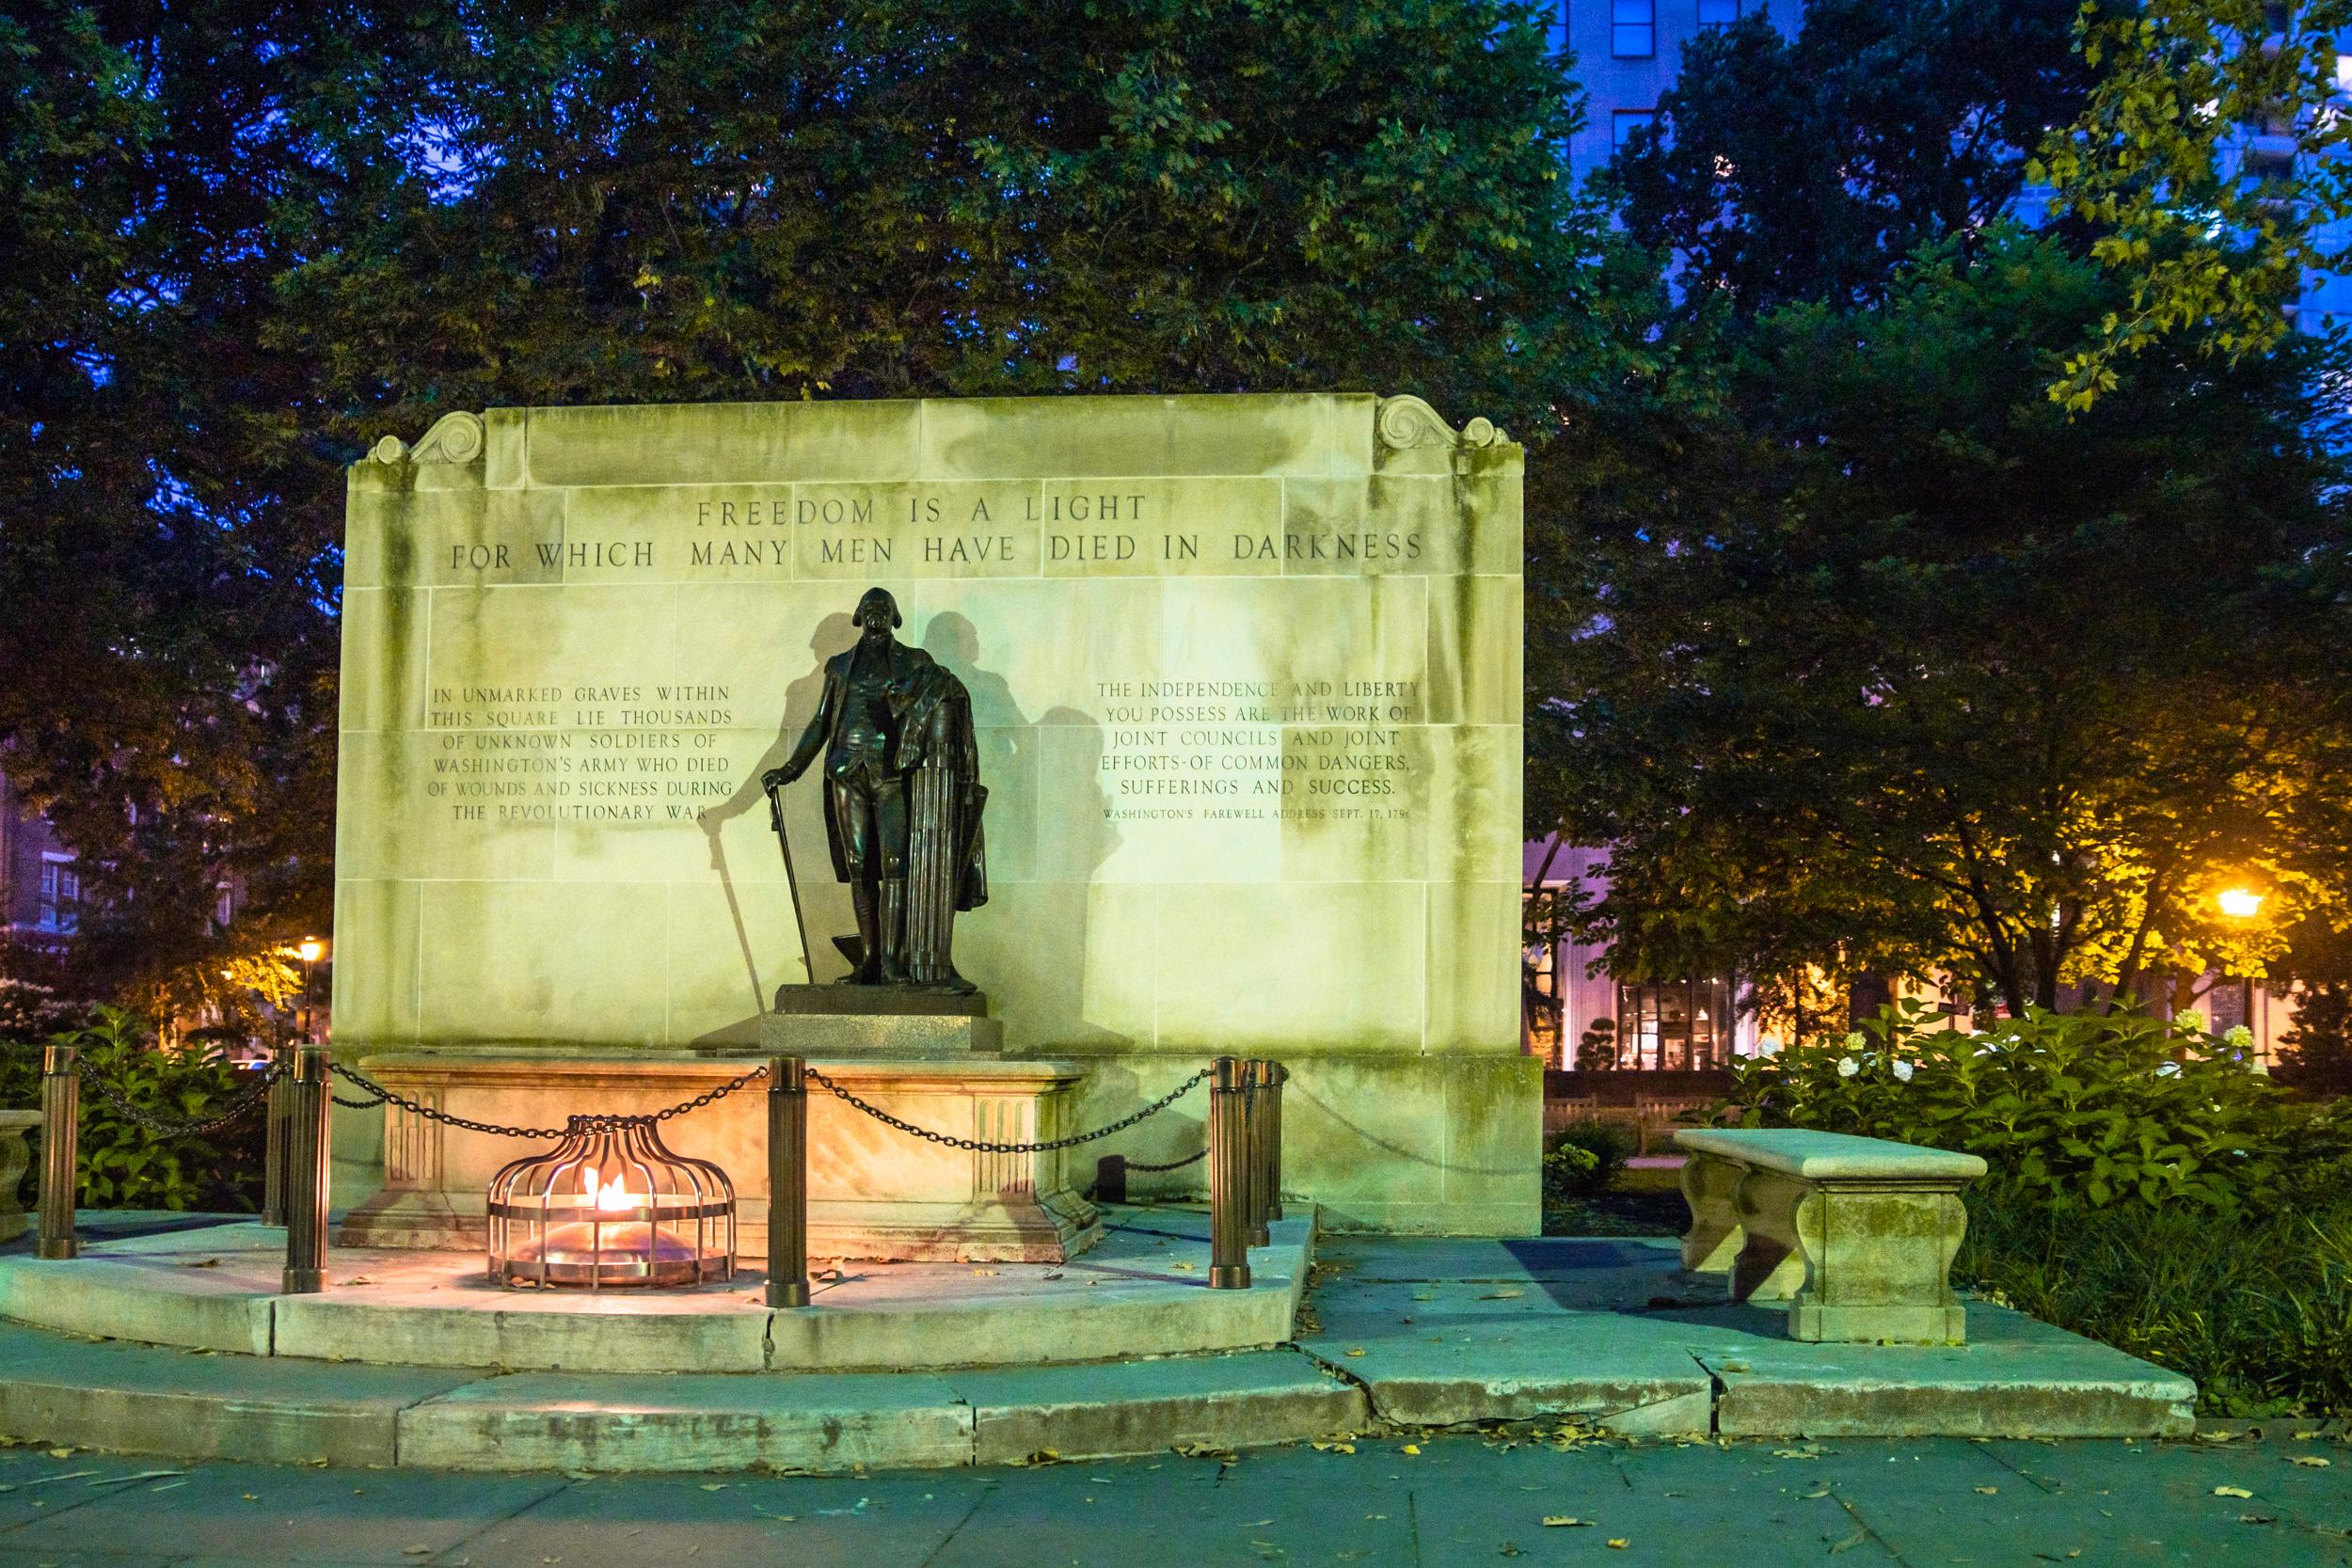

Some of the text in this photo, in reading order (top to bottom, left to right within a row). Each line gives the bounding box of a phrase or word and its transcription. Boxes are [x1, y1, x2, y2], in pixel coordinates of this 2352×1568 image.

[697, 495, 1146, 527] FREEDOM IS A LIGHT
[453, 532, 1422, 569] FOR WHICH MANY MEN HAVE DIED IN DARKNESS
[434, 686, 729, 703] IN UNMARKED GRAVES WITHIN
[1098, 681, 1419, 697] THE INDEPENDENCE AND LIBERTY
[431, 709, 732, 728] THIS SQUARE LIE THOUSANDS
[1106, 706, 1412, 722] YOU POSSESS ARE THE WORK OF
[442, 733, 716, 751] OF UNKNOWN SOLDIERS OF
[1114, 730, 1400, 749] JOINT COUNCILS AND JOINT
[434, 755, 729, 774] WASHINGTON'S ARMY WHO DIED
[1221, 754, 1308, 770] COMMON
[1319, 754, 1410, 772] DANGERS,
[427, 781, 732, 797] OF WOUNDS AND SICKNESS DURING
[1120, 779, 1395, 795] SUFFERINGS AND SUCCESS.
[453, 804, 707, 820] THE REVOLUTIONARY WAR
[1104, 808, 1411, 820] WASHINGTON'S FAREWELL ADDRESS SEPT. 17, 1796
